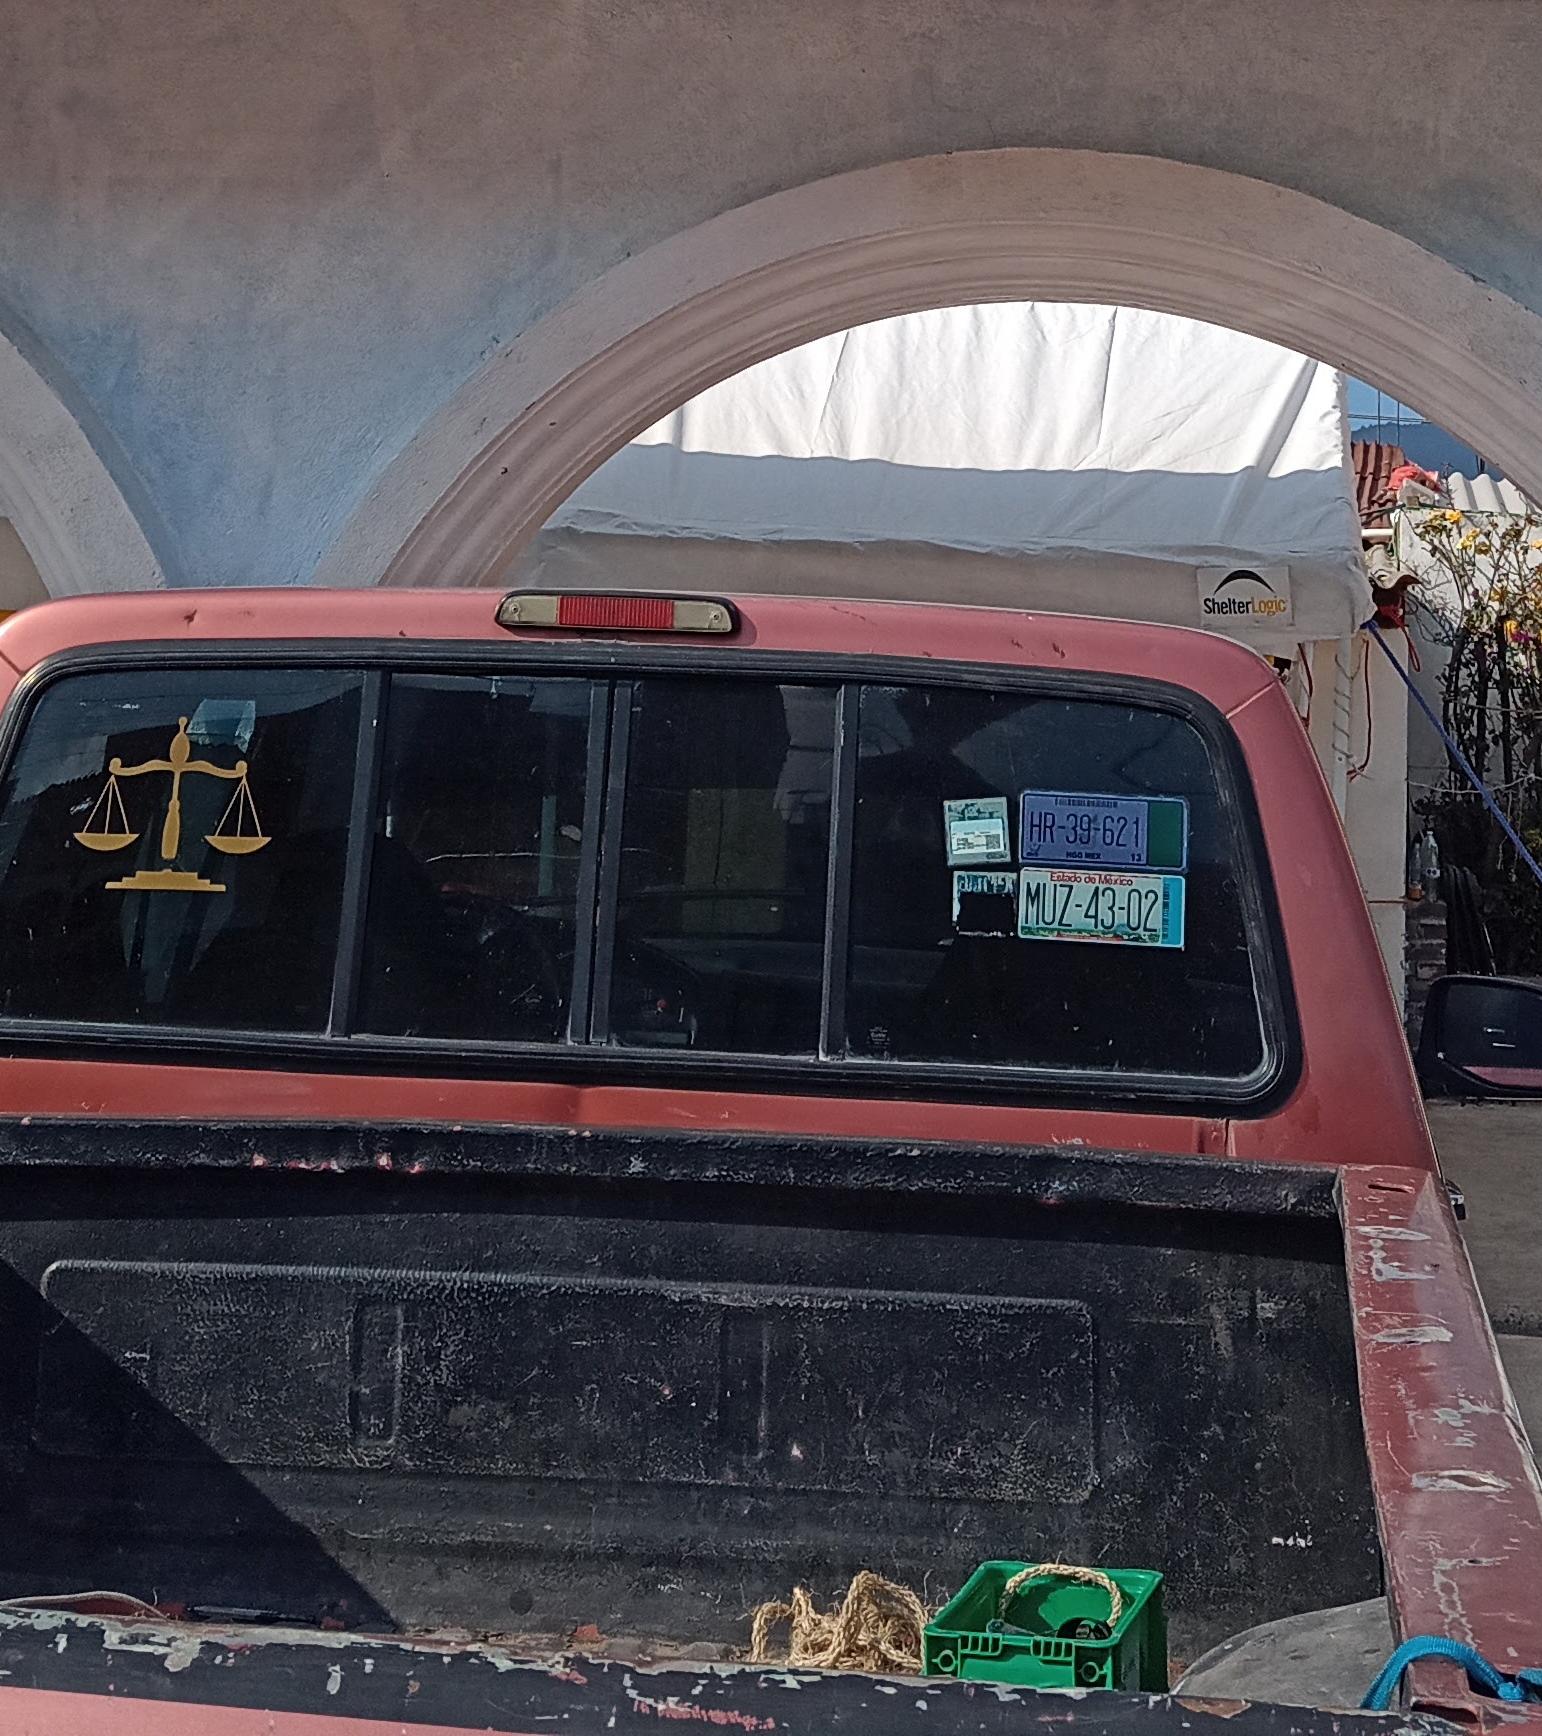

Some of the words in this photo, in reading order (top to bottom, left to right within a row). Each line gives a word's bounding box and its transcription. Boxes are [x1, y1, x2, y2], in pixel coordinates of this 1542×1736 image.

[1203, 595, 1287, 616] ShelterLogic
[1029, 811, 1140, 848] HR-39-621
[1049, 872, 1082, 883] Estado
[1084, 874, 1096, 884] de
[1098, 874, 1134, 887] México
[1024, 881, 1159, 933] MUZ-43-02
